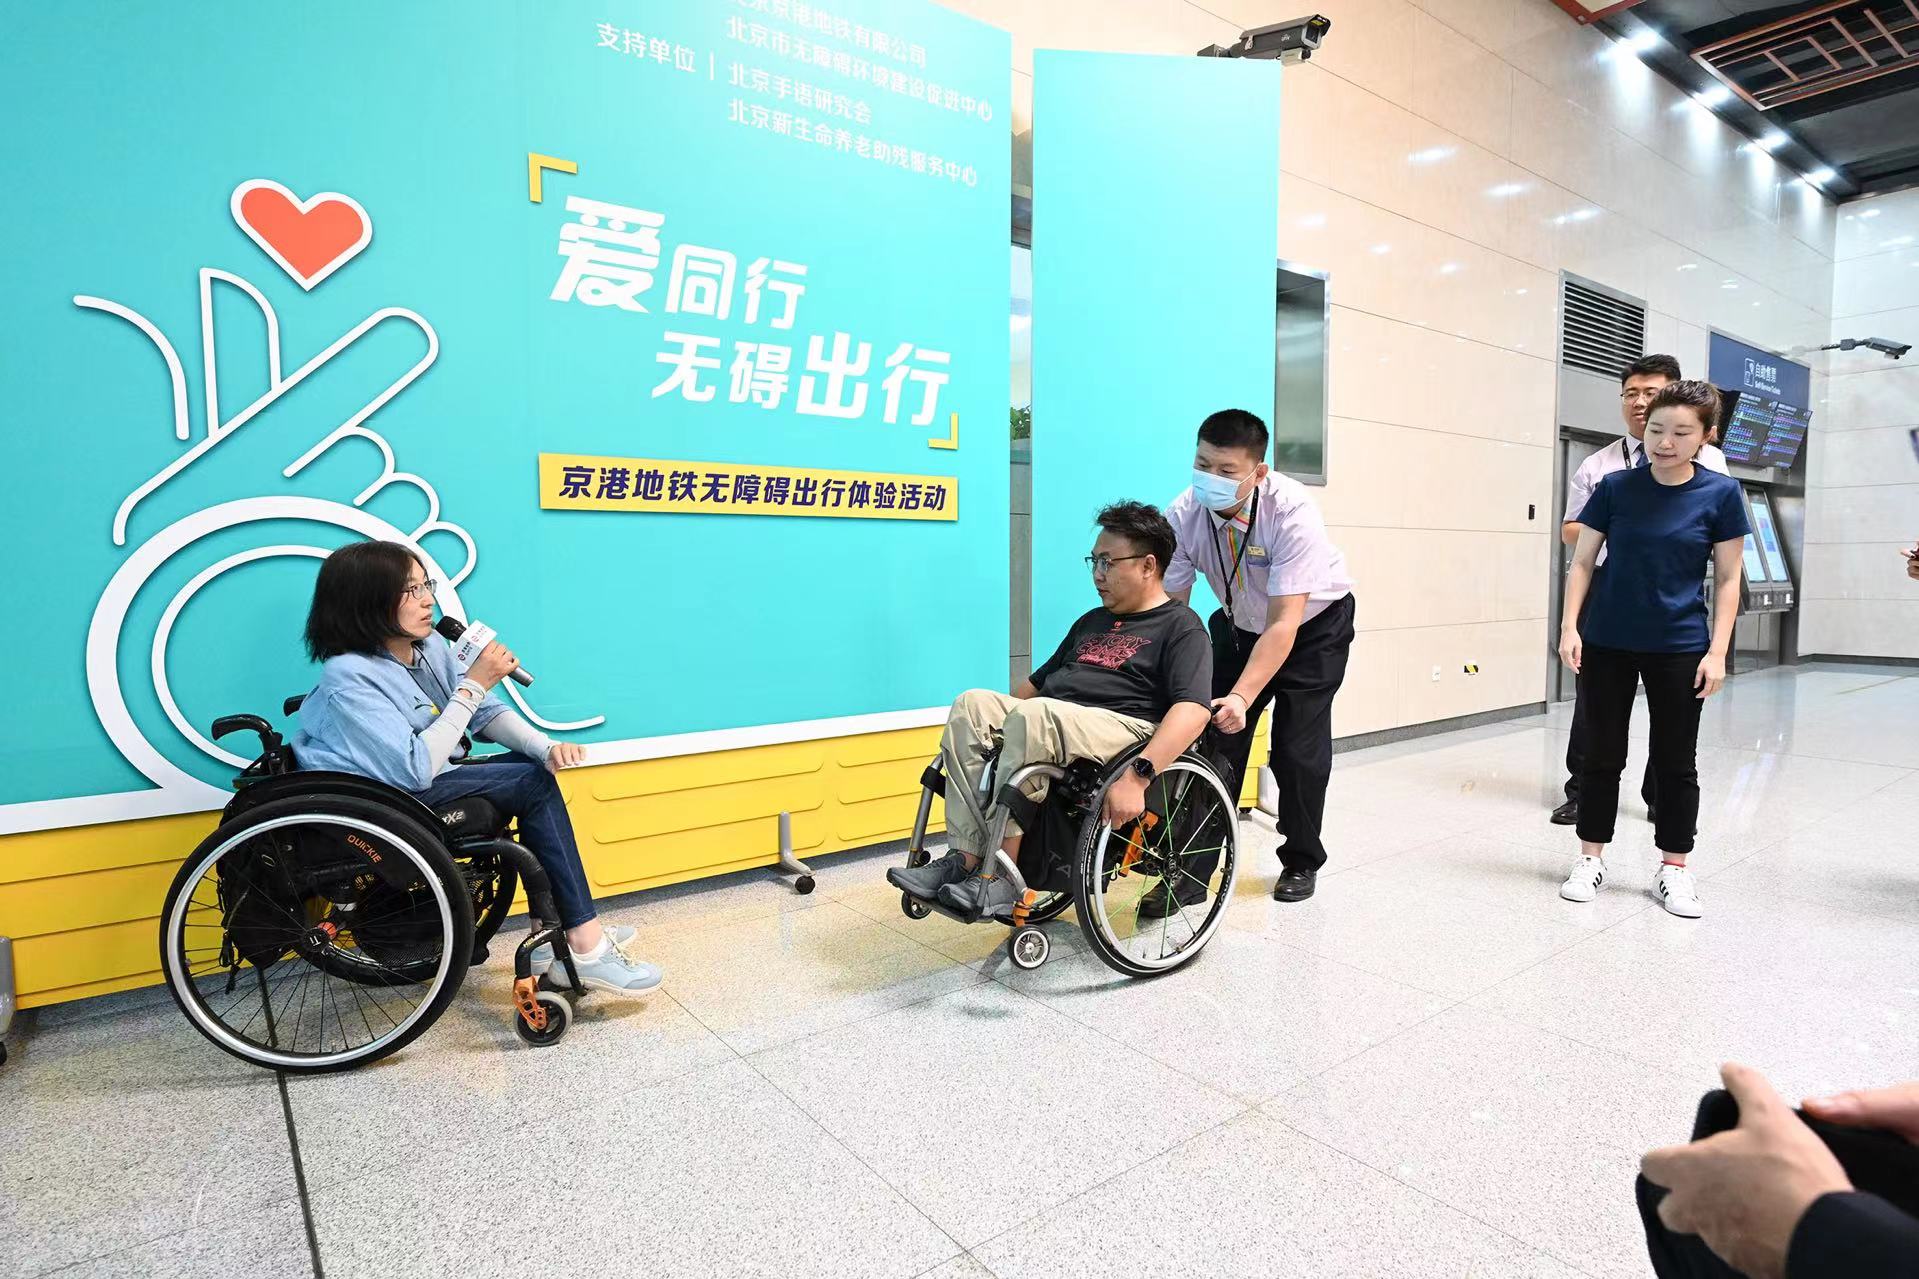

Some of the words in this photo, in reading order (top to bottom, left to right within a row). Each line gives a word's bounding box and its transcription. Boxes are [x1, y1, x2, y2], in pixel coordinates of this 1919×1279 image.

[597, 22, 696, 73] 支持单位
[727, 16, 993, 122] 北京市无障碍环境建设促进中心
[728, 62, 872, 126] 北京手语研究会
[728, 98, 978, 187] 北京新生命养老助残服务中心
[549, 195, 808, 330] 爱同行
[651, 331, 951, 426] 无碍出行
[559, 465, 947, 511] 京港地铁无障碍出行体验活动
[347, 834, 383, 863] QUICKIE
